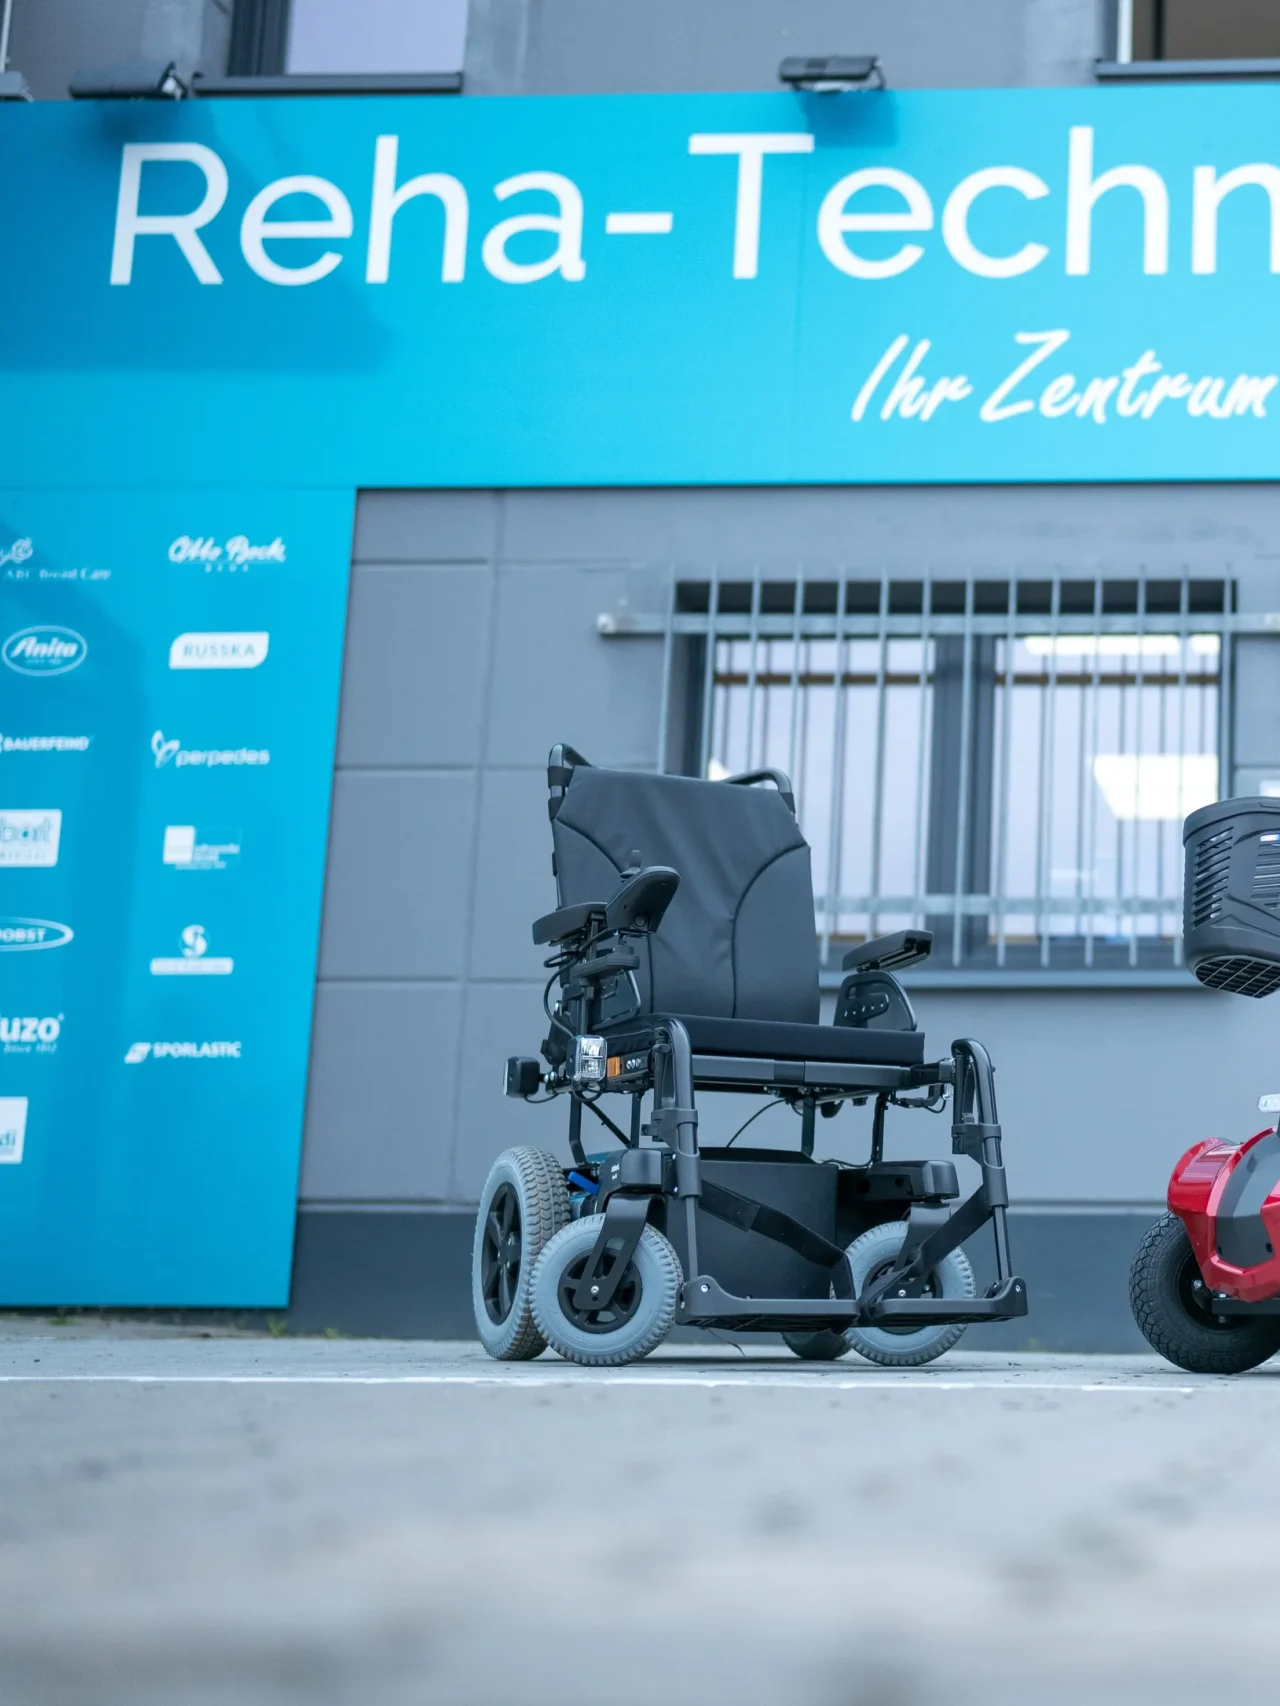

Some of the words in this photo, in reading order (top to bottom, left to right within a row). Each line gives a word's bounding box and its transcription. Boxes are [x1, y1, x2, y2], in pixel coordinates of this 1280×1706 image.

[851, 333, 972, 423] Ihr
[978, 328, 1279, 424] Zentrum
[10, 636, 78, 658] Anita
[182, 642, 257, 658] RUSSKA
[3, 736, 89, 751] BAUERFEIND
[176, 747, 270, 767] perpedes
[0, 927, 46, 943] OBST
[0, 1014, 61, 1043] uzo
[152, 1041, 242, 1058] SPORLASTIC
